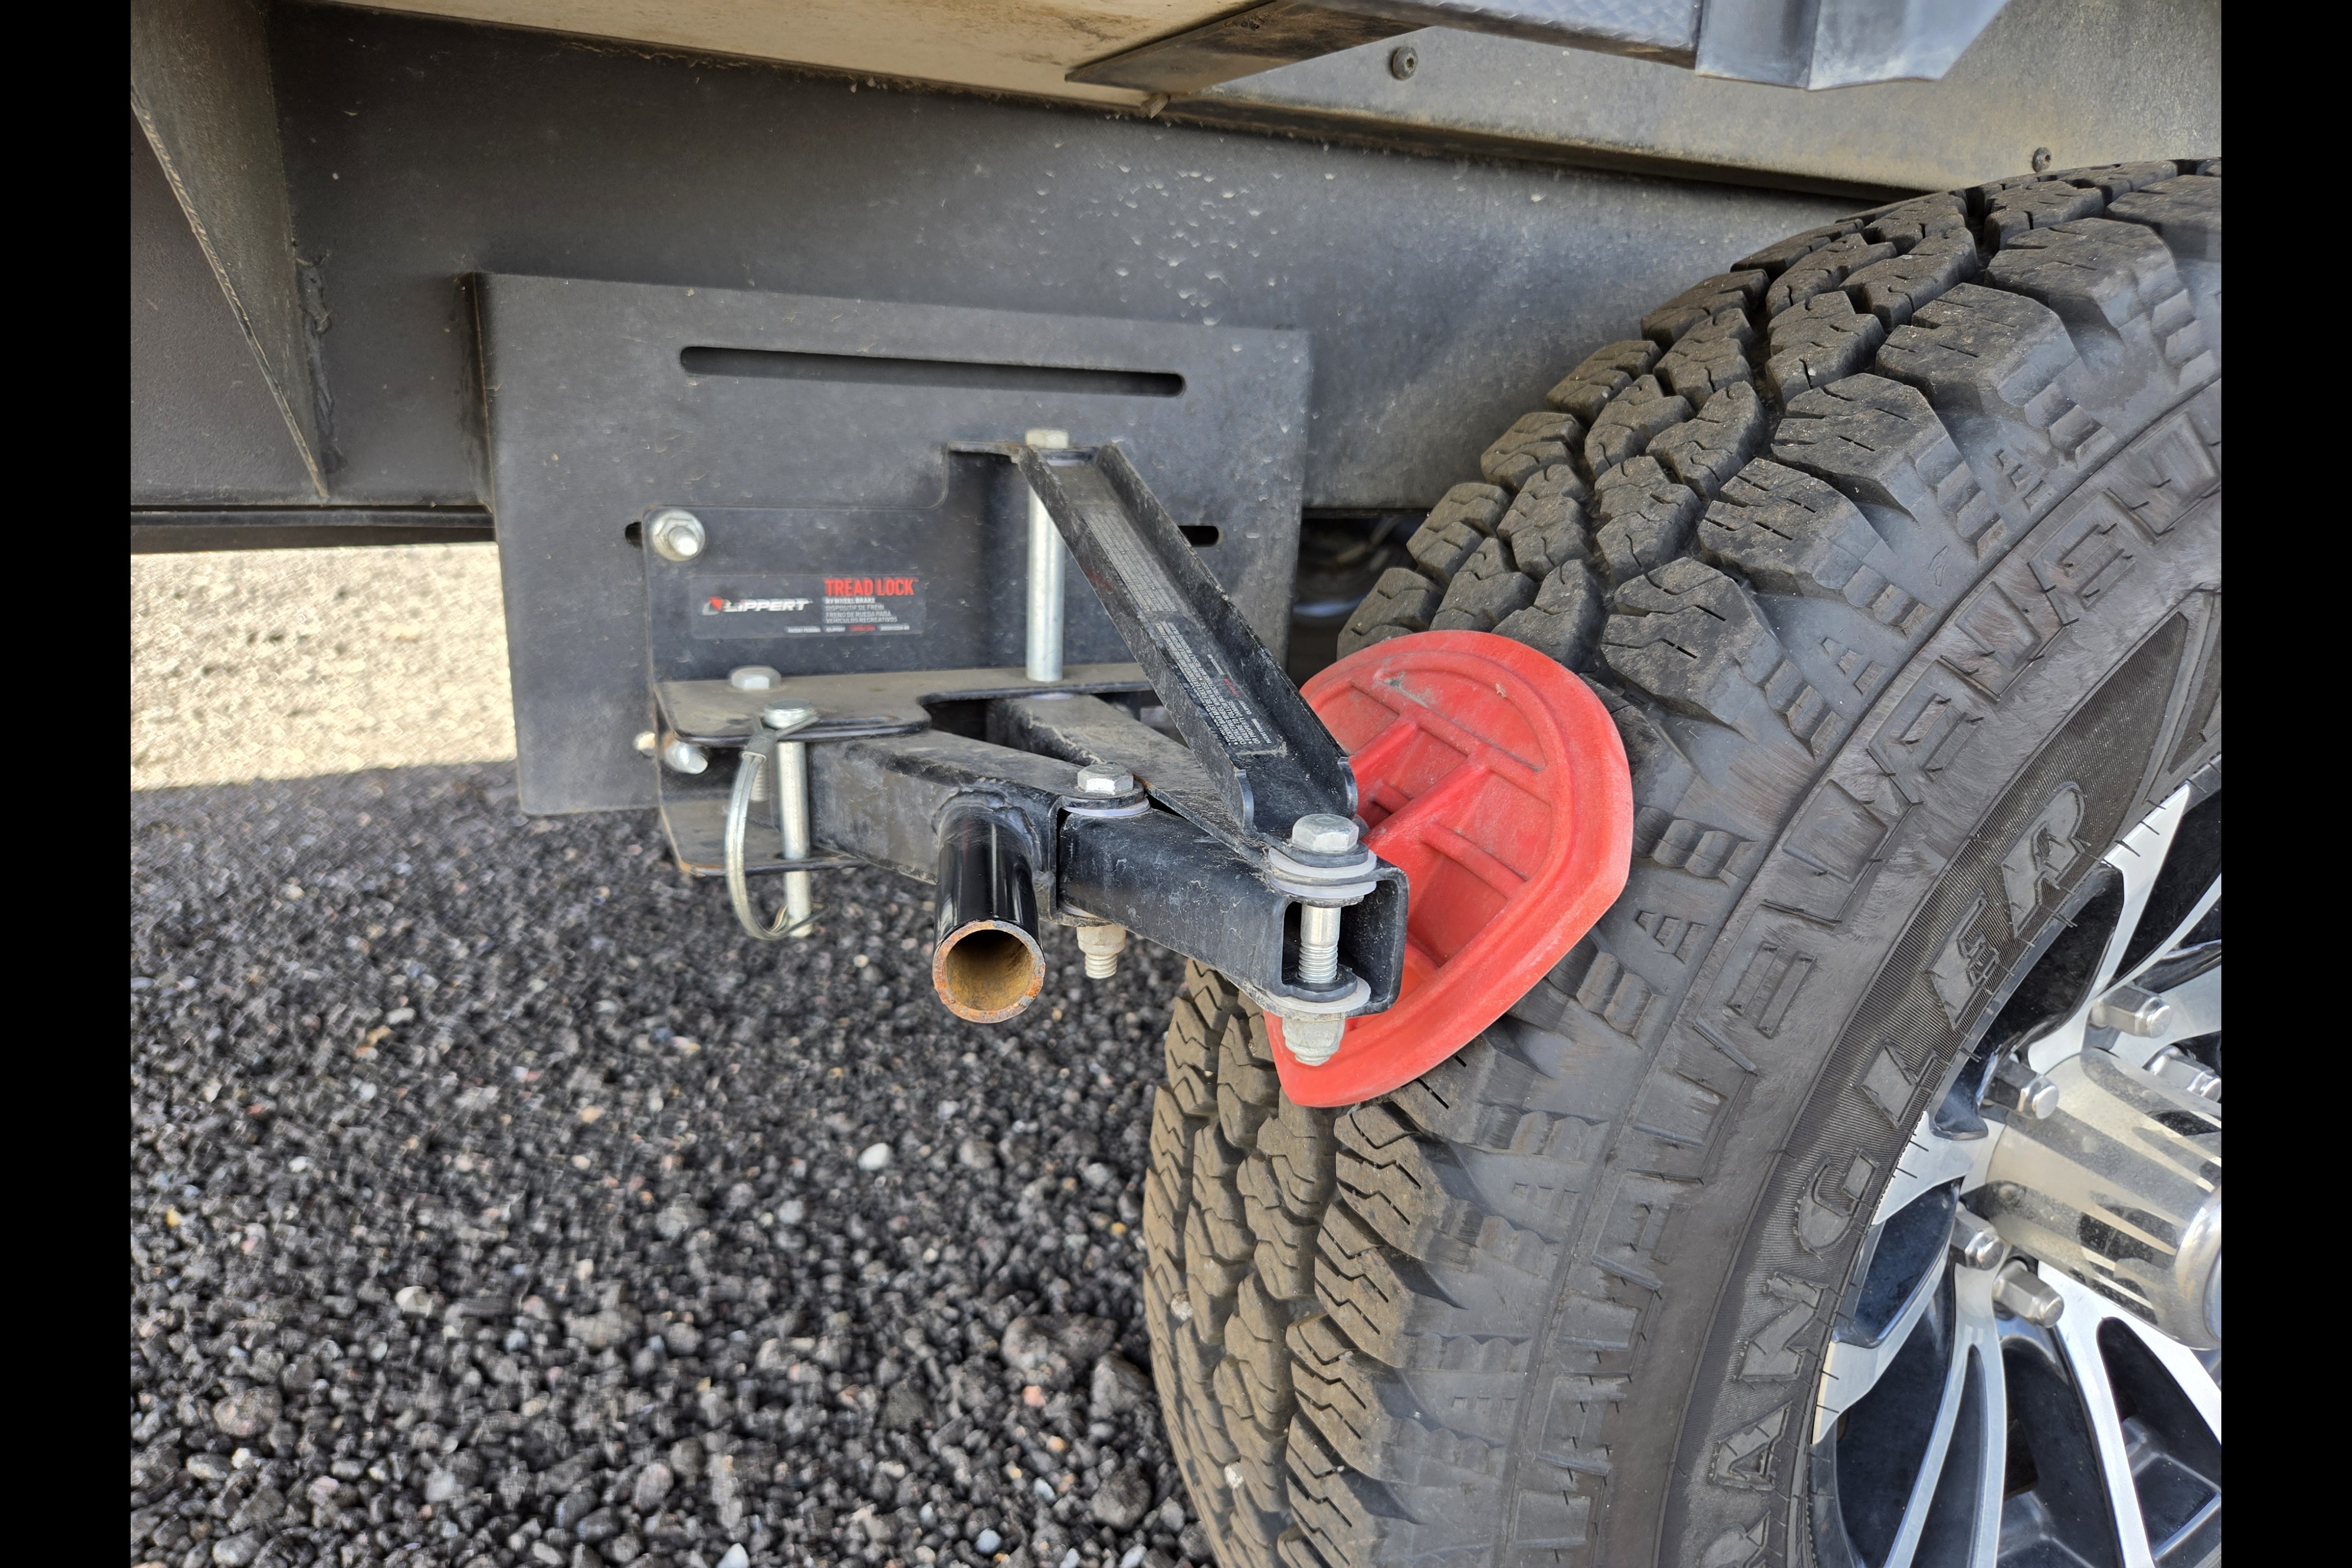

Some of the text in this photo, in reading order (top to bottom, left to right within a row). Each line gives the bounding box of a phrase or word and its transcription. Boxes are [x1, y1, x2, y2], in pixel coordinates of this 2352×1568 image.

[825, 579, 873, 596] TREAD
[722, 599, 811, 612] LIPPERT
[1179, 659, 1187, 667] AND
[1189, 653, 1201, 667] RESULT
[1187, 662, 1201, 677] REMOVE
[1197, 667, 1207, 675] MAY
[1184, 667, 1201, 687] EXTENDED
[1196, 687, 1208, 698] FULLY
[1203, 675, 1225, 702] INSTRUCTIONS
[1208, 694, 1220, 706] WHEN
[1208, 704, 1219, 716] MUST
[1216, 705, 1229, 719] WHEEL
[1221, 702, 1236, 718] FOLLOW
[1216, 715, 1225, 724] BAR
[1220, 724, 1236, 742] LOCKING
[1225, 719, 1246, 745] CONTACTING
[1236, 724, 1251, 741] FAILURE
[1238, 717, 1255, 737] PROPERTY
[1261, 732, 1272, 743] PATENT
